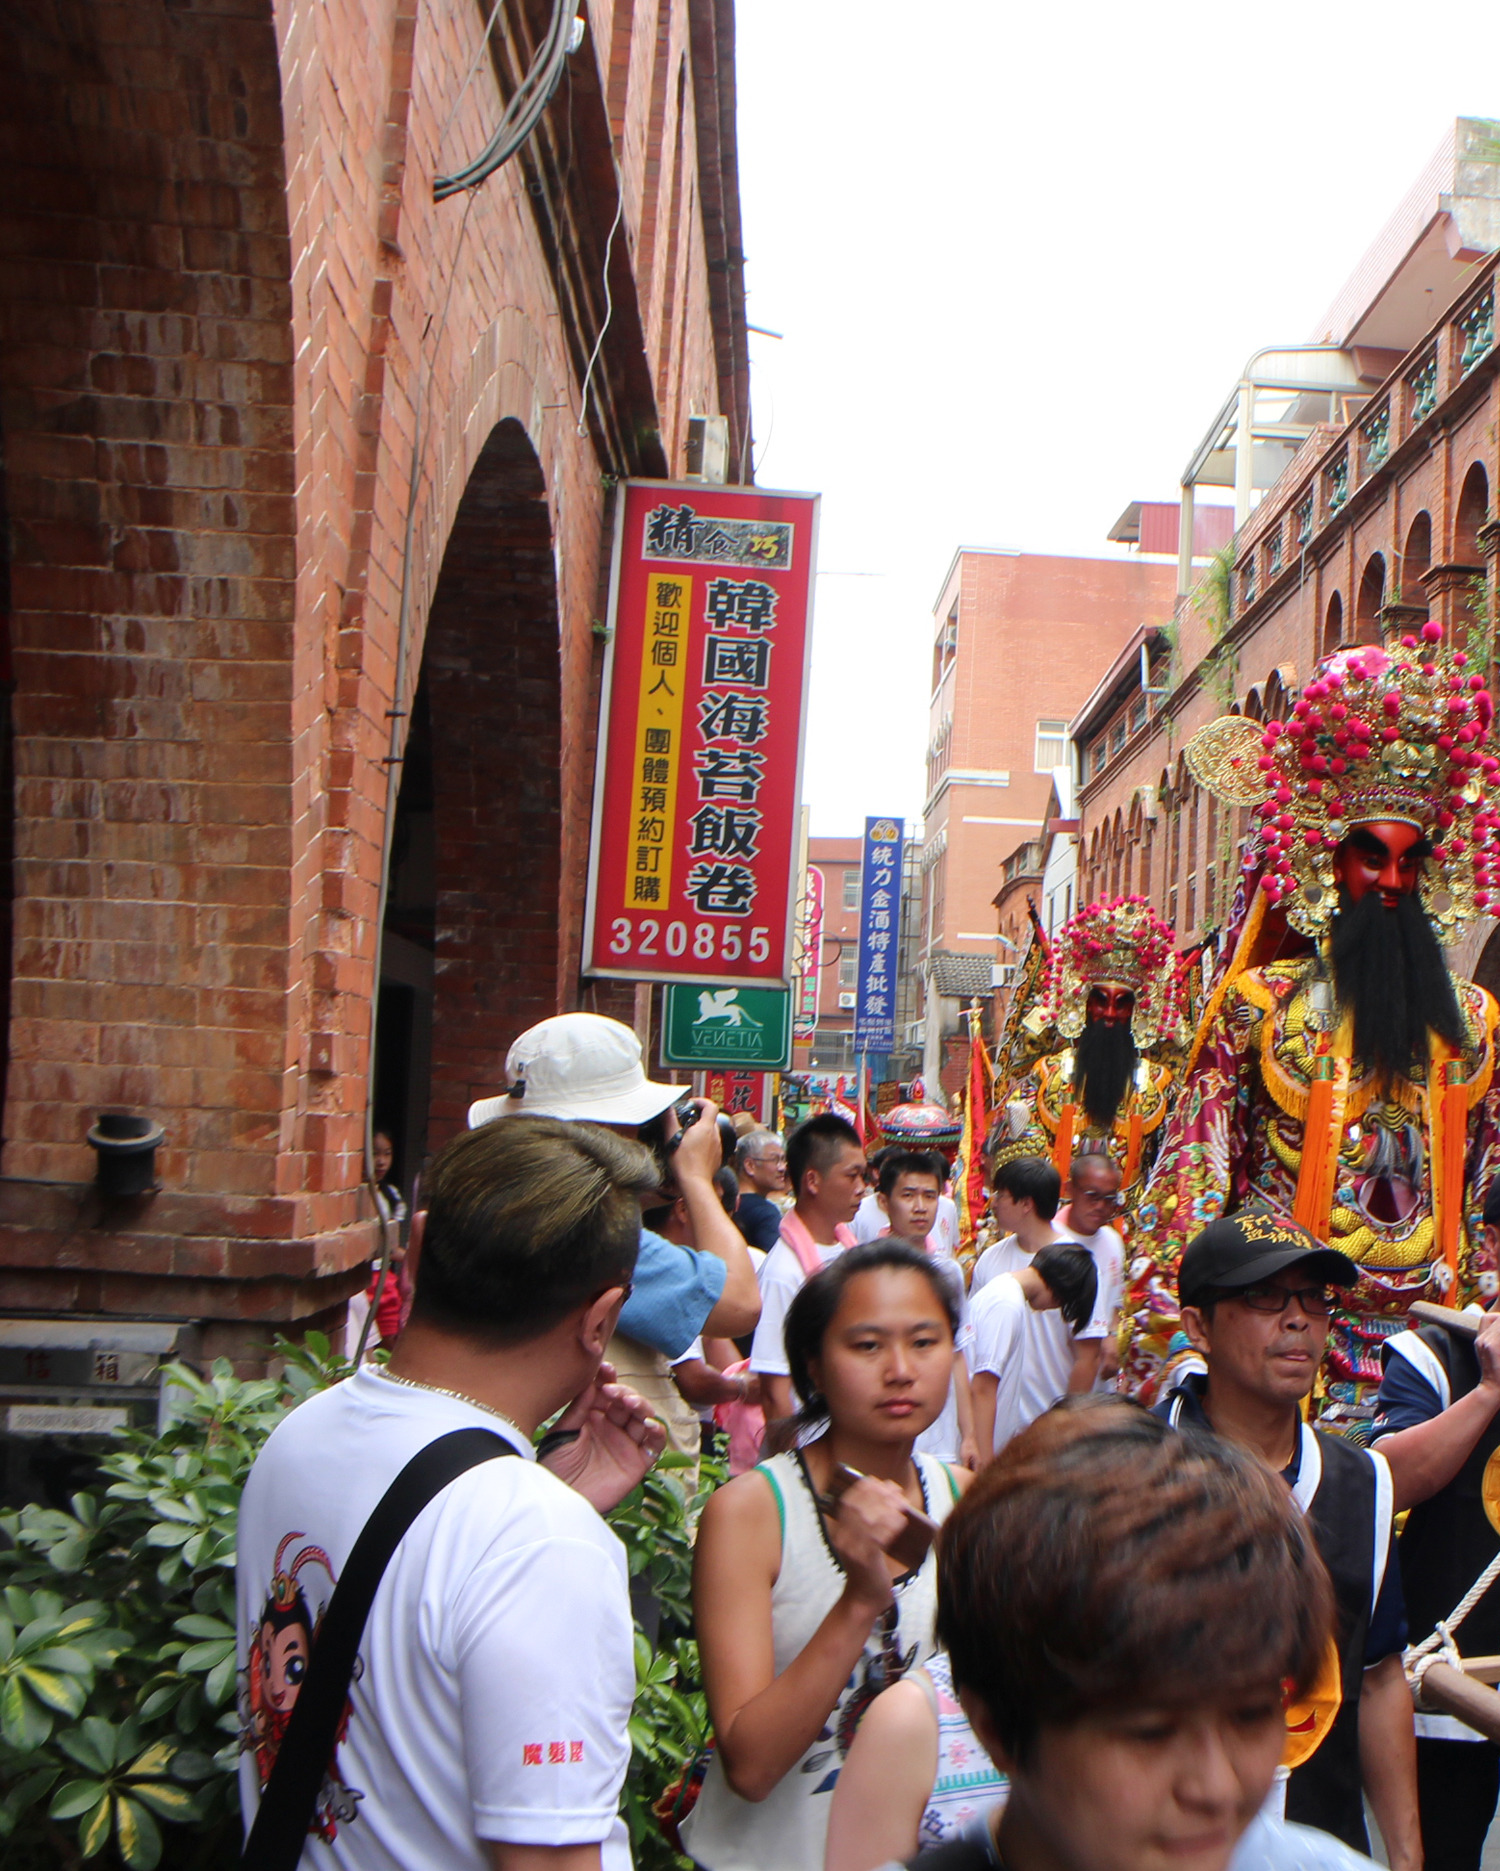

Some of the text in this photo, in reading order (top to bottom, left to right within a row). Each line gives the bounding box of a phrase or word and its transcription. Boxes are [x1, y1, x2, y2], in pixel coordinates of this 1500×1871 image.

[633, 582, 682, 902] 歡迎個人、團體預約訂購
[684, 577, 781, 917] 韓國海苔飯卷
[609, 917, 770, 963] 320855
[864, 845, 895, 1016] 統力金酒特產批發
[691, 1029, 763, 1048] VENETIA
